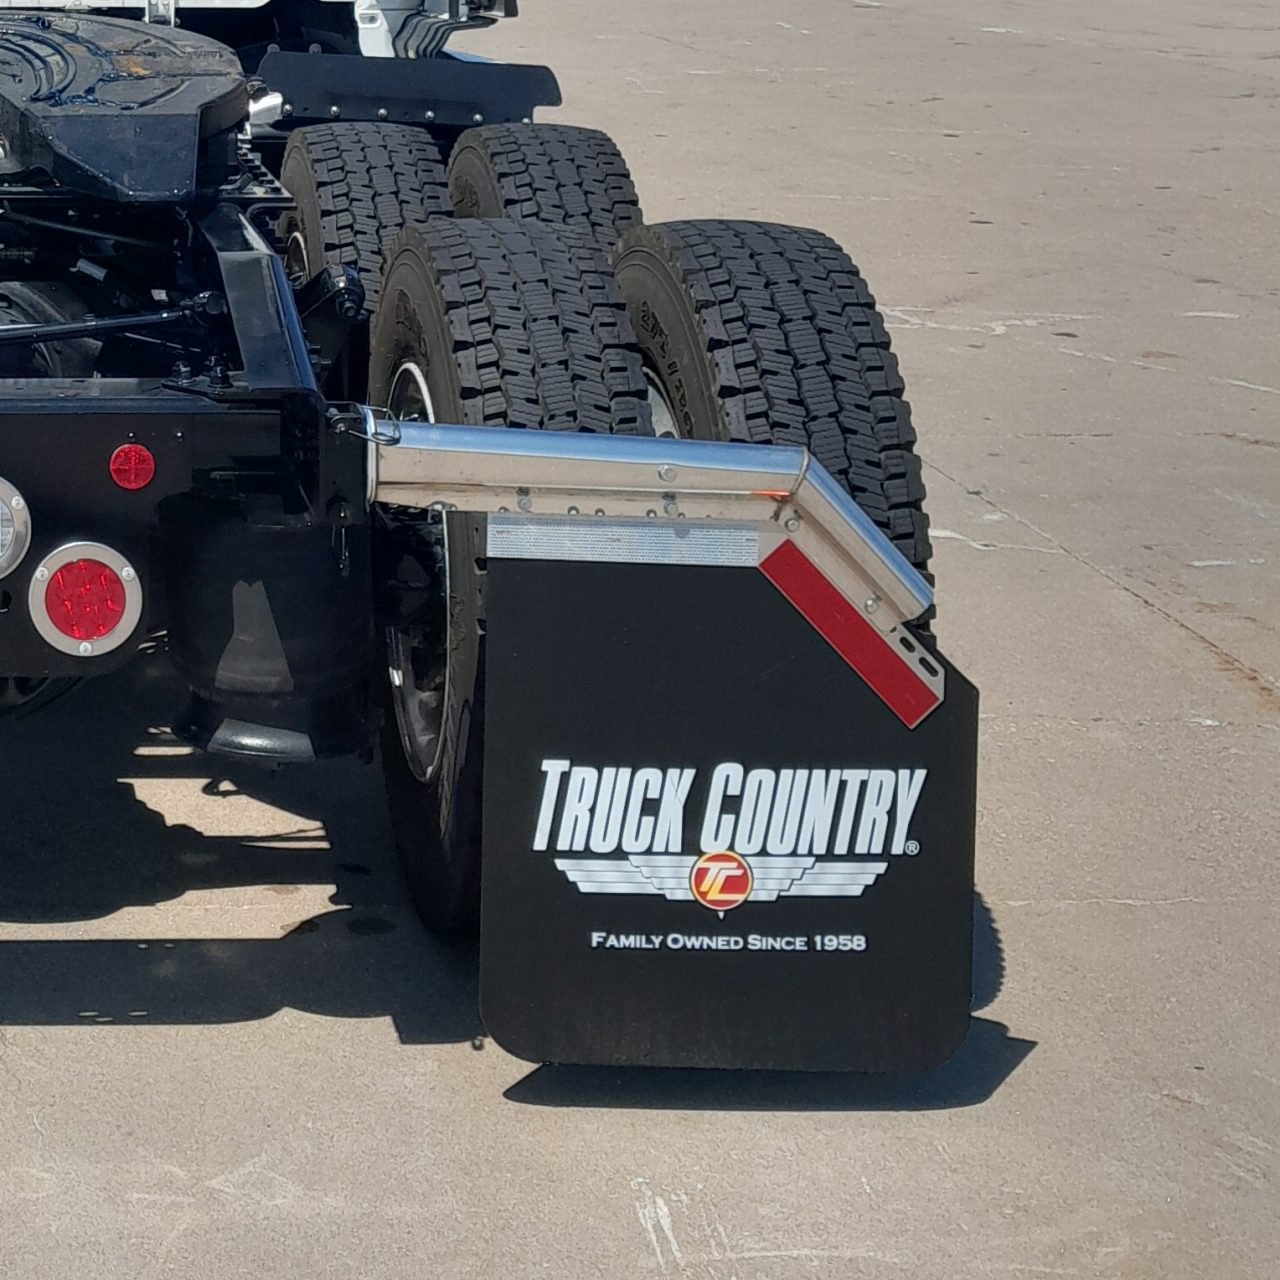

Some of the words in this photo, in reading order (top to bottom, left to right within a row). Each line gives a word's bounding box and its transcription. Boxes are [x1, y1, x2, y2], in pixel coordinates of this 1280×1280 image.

[532, 759, 697, 854] TRUCK
[591, 931, 663, 949] FAMILY
[666, 933, 744, 950] OWNED
[747, 934, 808, 951] SINCE
[814, 934, 867, 951] 1958
